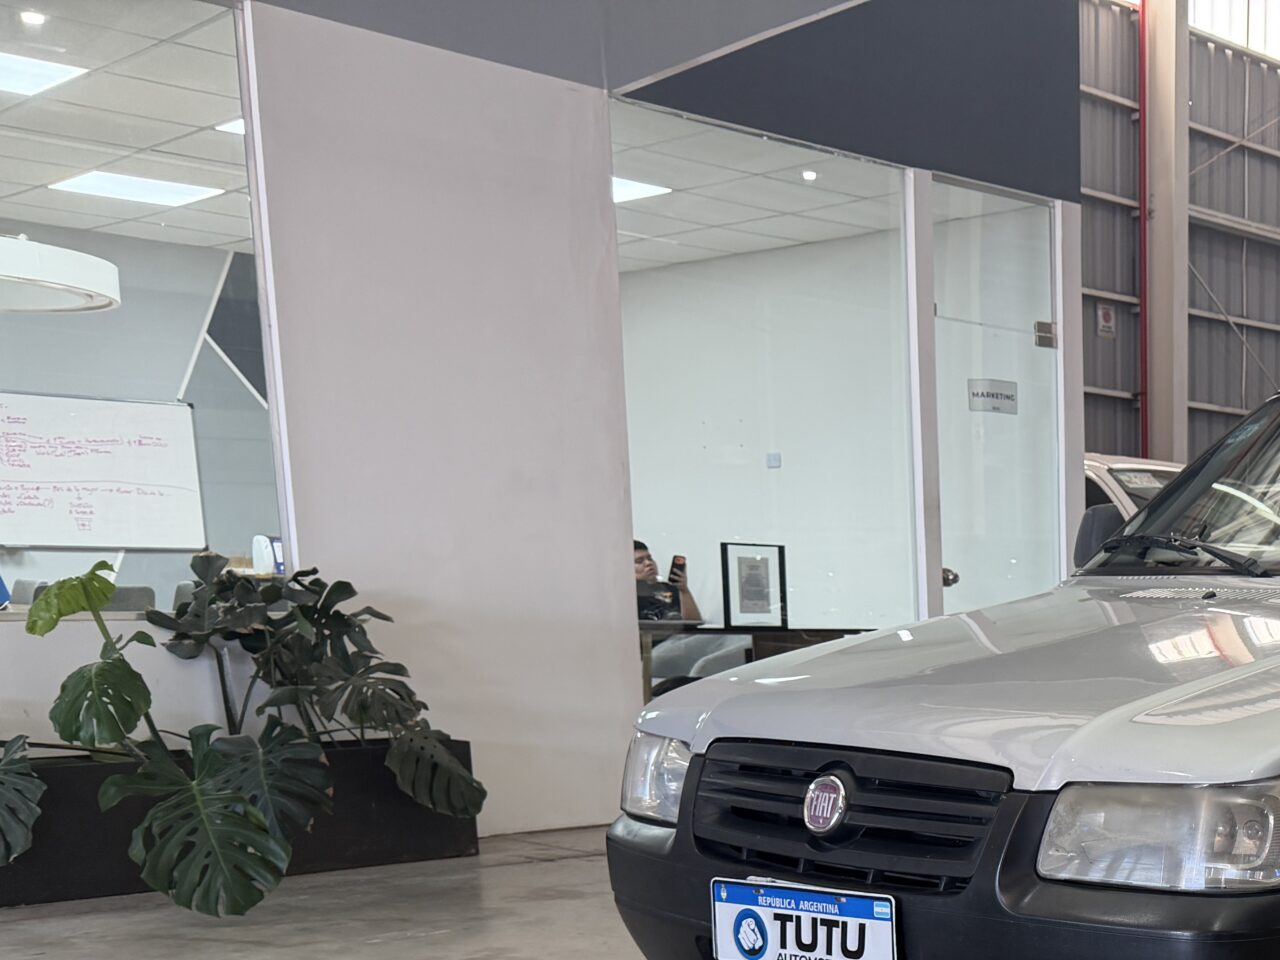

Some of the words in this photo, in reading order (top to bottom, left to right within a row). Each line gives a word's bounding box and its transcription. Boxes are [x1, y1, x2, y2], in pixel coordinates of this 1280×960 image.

[972, 391, 1015, 402] MARKETING
[811, 790, 837, 818] FIAT
[758, 895, 796, 910] REPÚBLICA
[799, 902, 840, 916] ARGENTINA
[773, 912, 866, 960] TUTU
